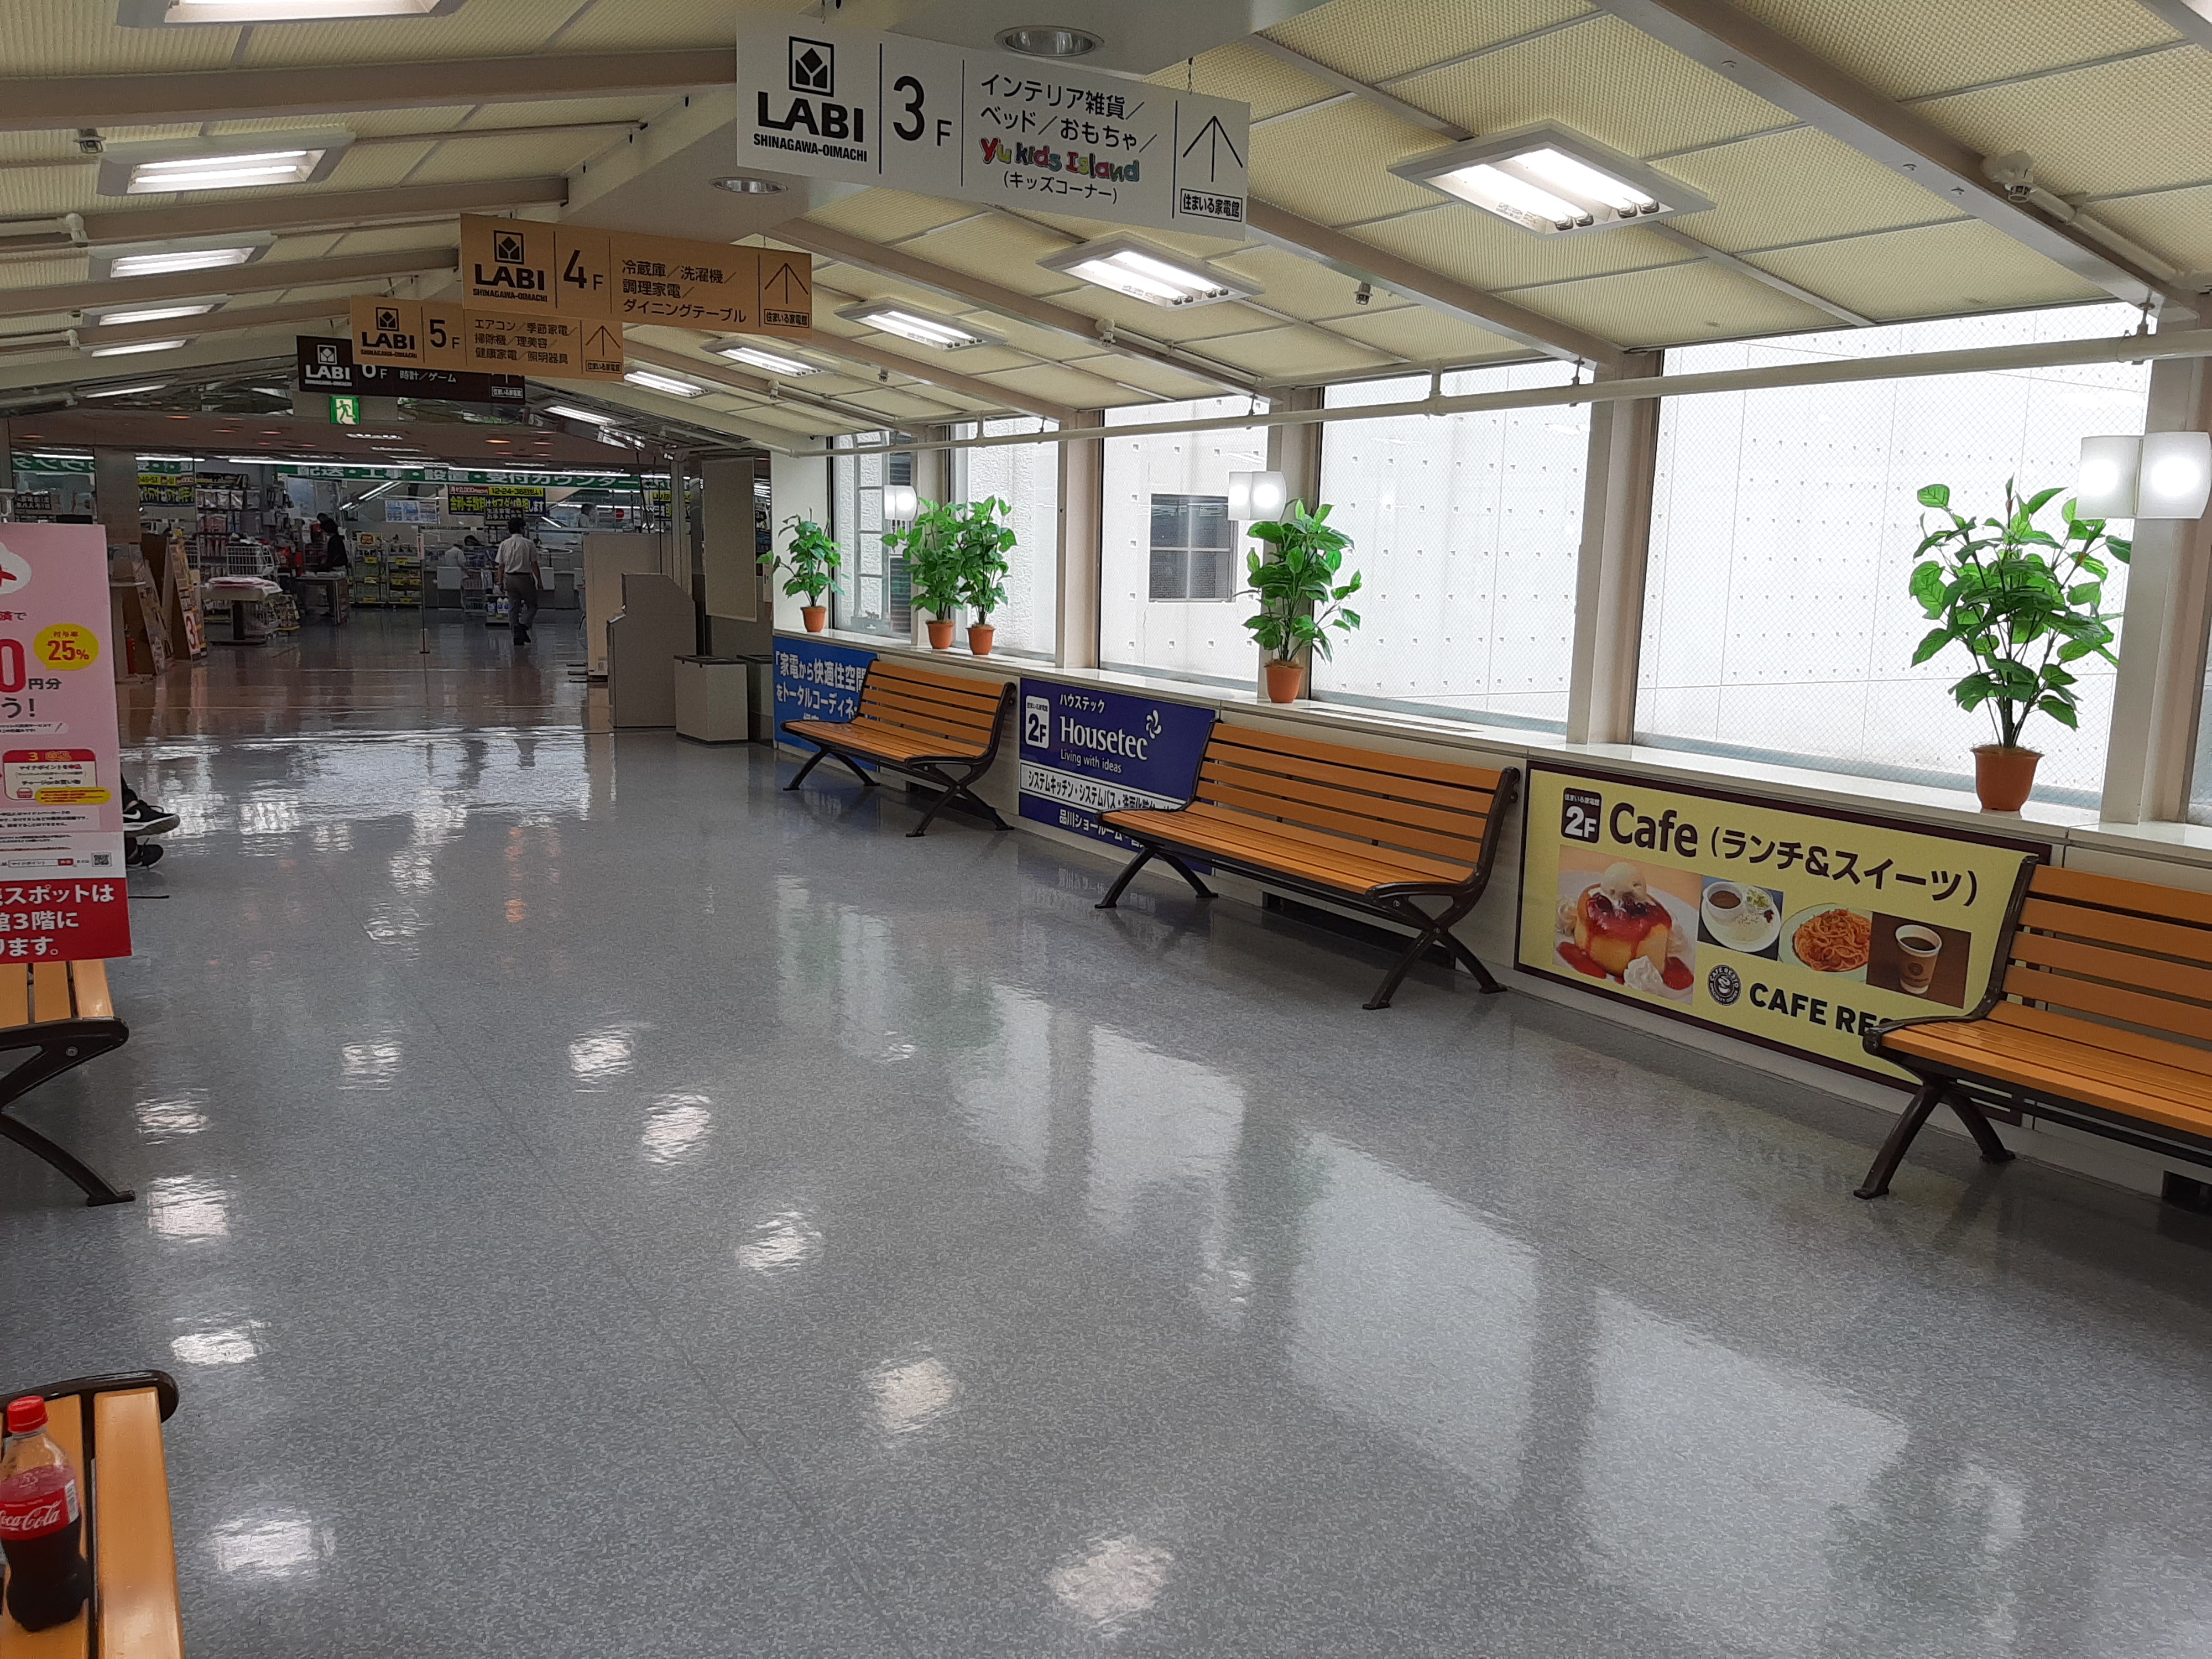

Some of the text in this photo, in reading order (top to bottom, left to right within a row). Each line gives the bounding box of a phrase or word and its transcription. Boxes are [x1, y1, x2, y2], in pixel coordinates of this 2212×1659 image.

[757, 91, 864, 143] LABI
[753, 132, 868, 163] SHINAGAWA-OIMACHI
[474, 263, 545, 290] LABI
[623, 299, 747, 324] ダイニングテーブル
[361, 331, 415, 350] LABI
[305, 364, 351, 380] LABI
[48, 640, 90, 660] 25%
[1058, 693, 1106, 714] ハウステック
[1027, 713, 1047, 744] 2F
[1058, 715, 1149, 761] Housetec
[1060, 748, 1123, 774] Living with ideas
[1564, 805, 1597, 838] 2F
[1609, 802, 1698, 858] Cafe
[0, 884, 115, 905] スポットは
[1749, 982, 1828, 1026] CAFE
